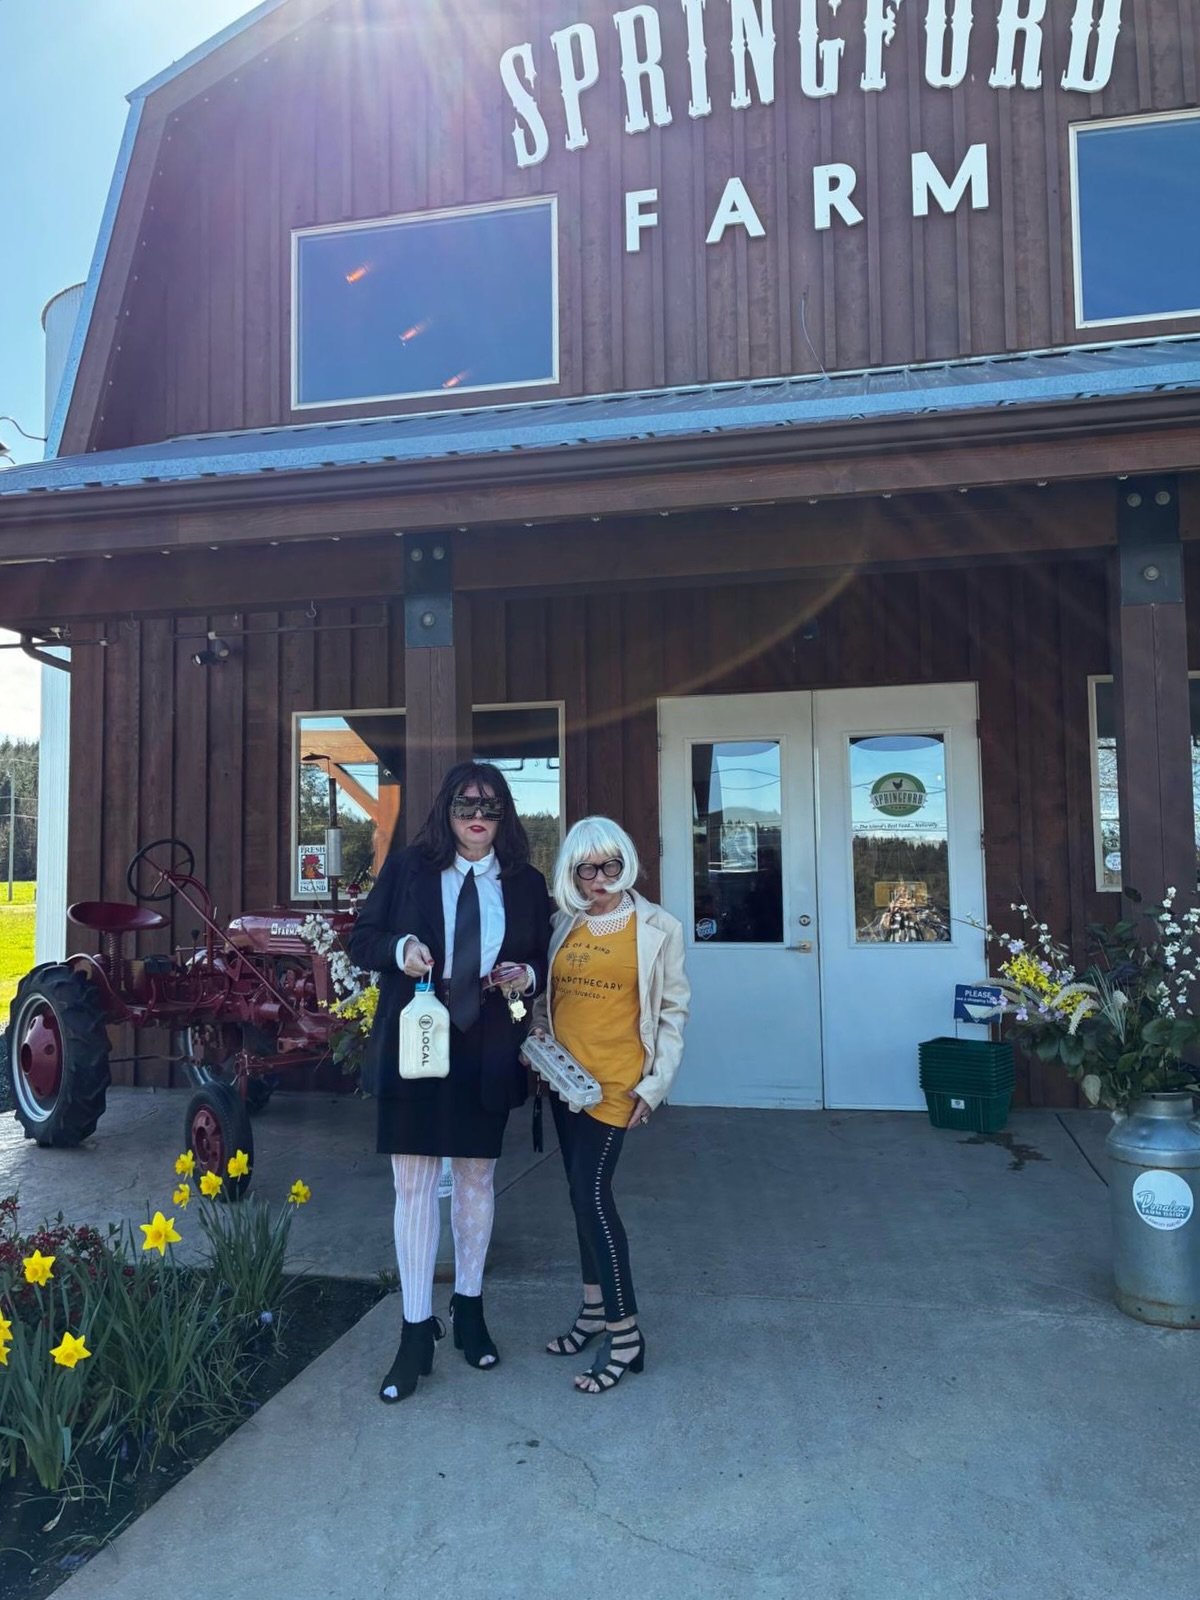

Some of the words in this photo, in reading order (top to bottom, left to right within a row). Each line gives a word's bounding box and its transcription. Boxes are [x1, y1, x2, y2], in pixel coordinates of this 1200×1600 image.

[499, 0, 1122, 169] SPRINGFORD
[625, 143, 990, 253] FARM
[874, 792, 922, 806] SPRINGFORD
[300, 846, 326, 854] FRESH
[964, 990, 992, 998] PLEASE
[422, 1031, 430, 1067] LOCAL
